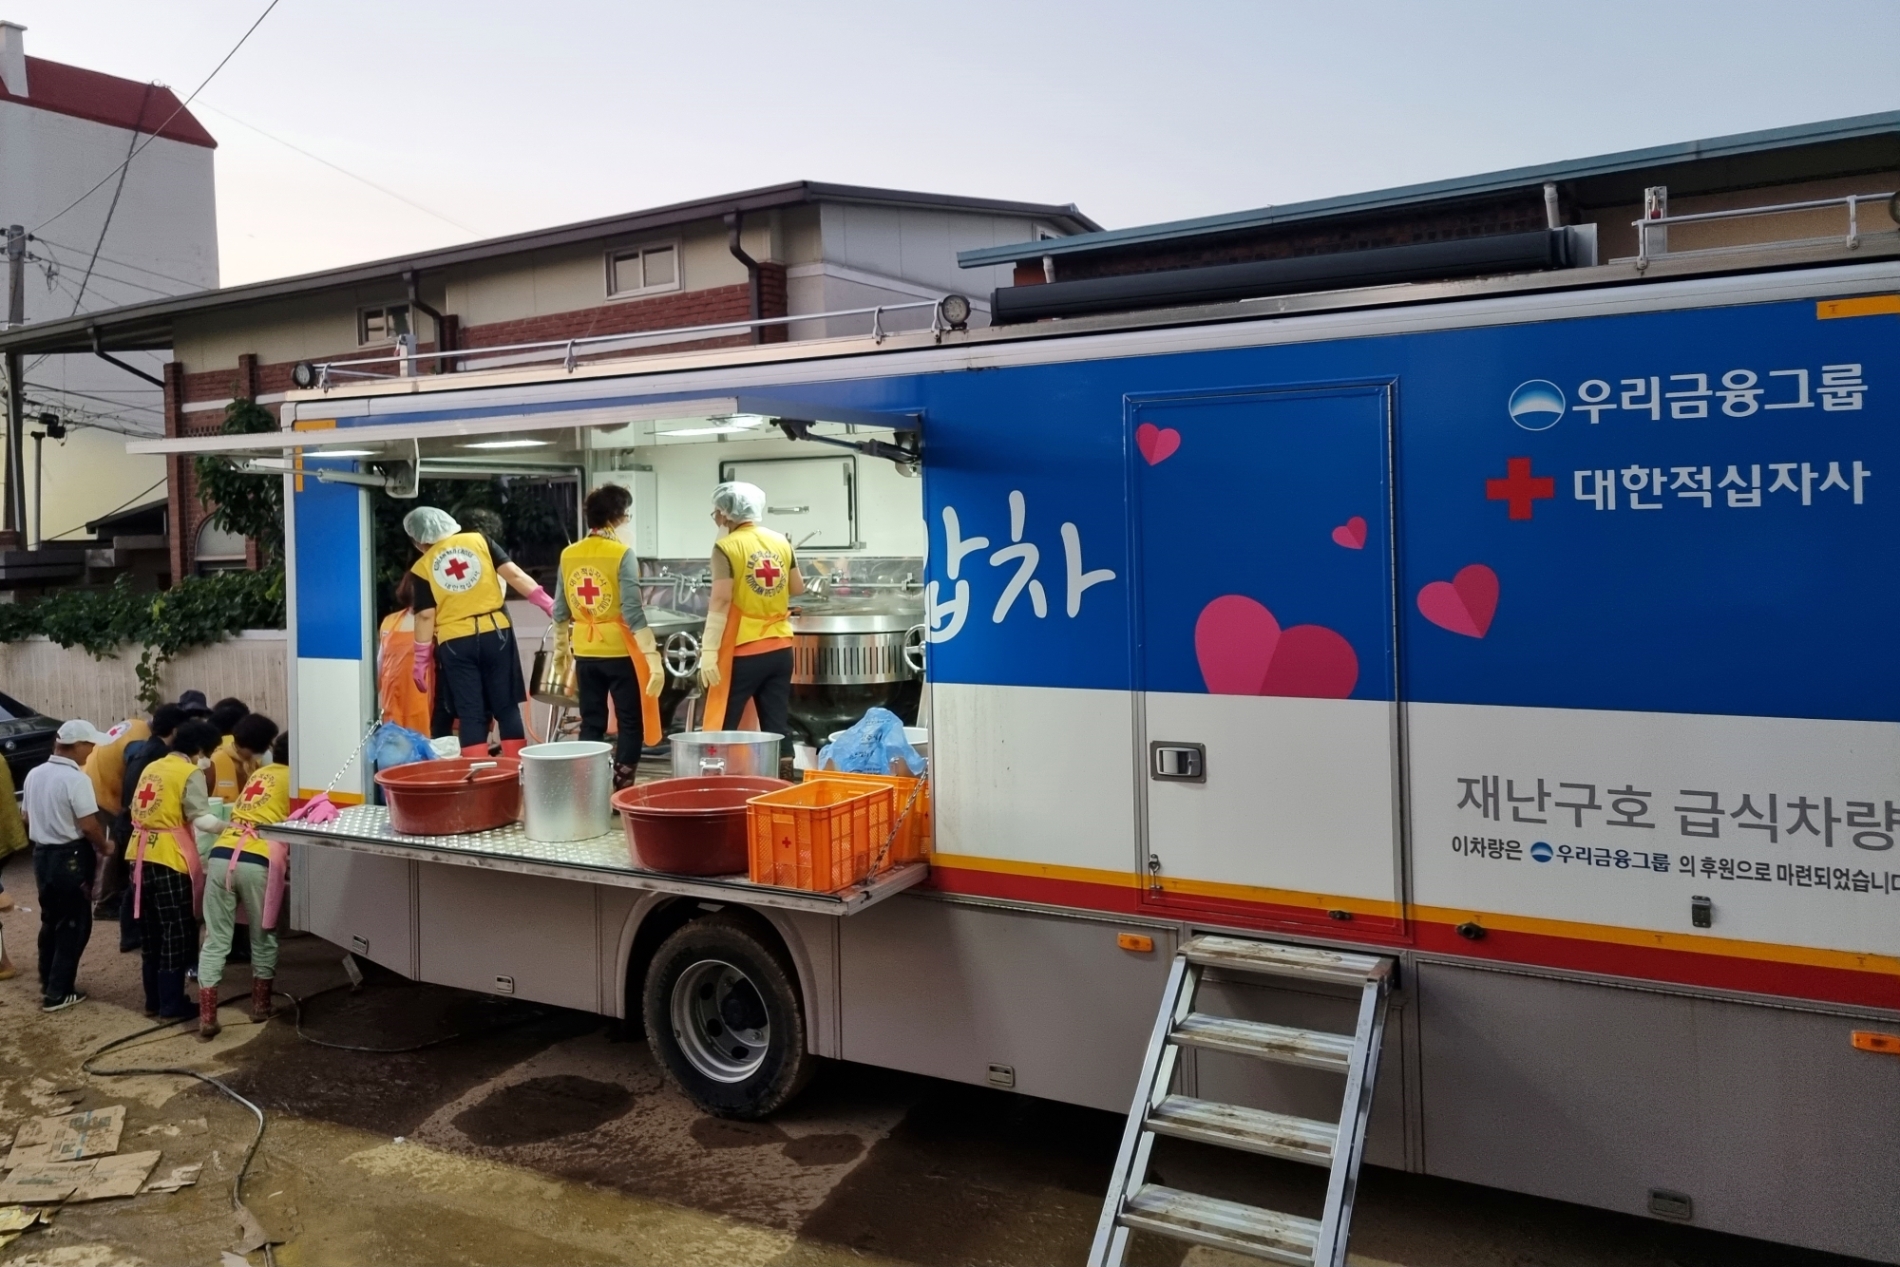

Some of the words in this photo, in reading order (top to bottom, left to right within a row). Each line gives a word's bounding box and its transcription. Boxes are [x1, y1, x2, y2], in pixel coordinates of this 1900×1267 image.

[1572, 363, 1868, 424] 우리금융그룹
[1574, 460, 1871, 511] 대한적십자사
[569, 566, 608, 587] 대한적십자사
[597, 593, 612, 613] CROSS
[1456, 775, 1656, 829] 재난구호
[1673, 789, 1900, 851] 급식차량
[1451, 835, 1523, 861] 이차량은
[1556, 844, 1671, 873] 우리금융그룹
[1679, 855, 1695, 878] 의
[1700, 856, 1772, 882] 후원으로
